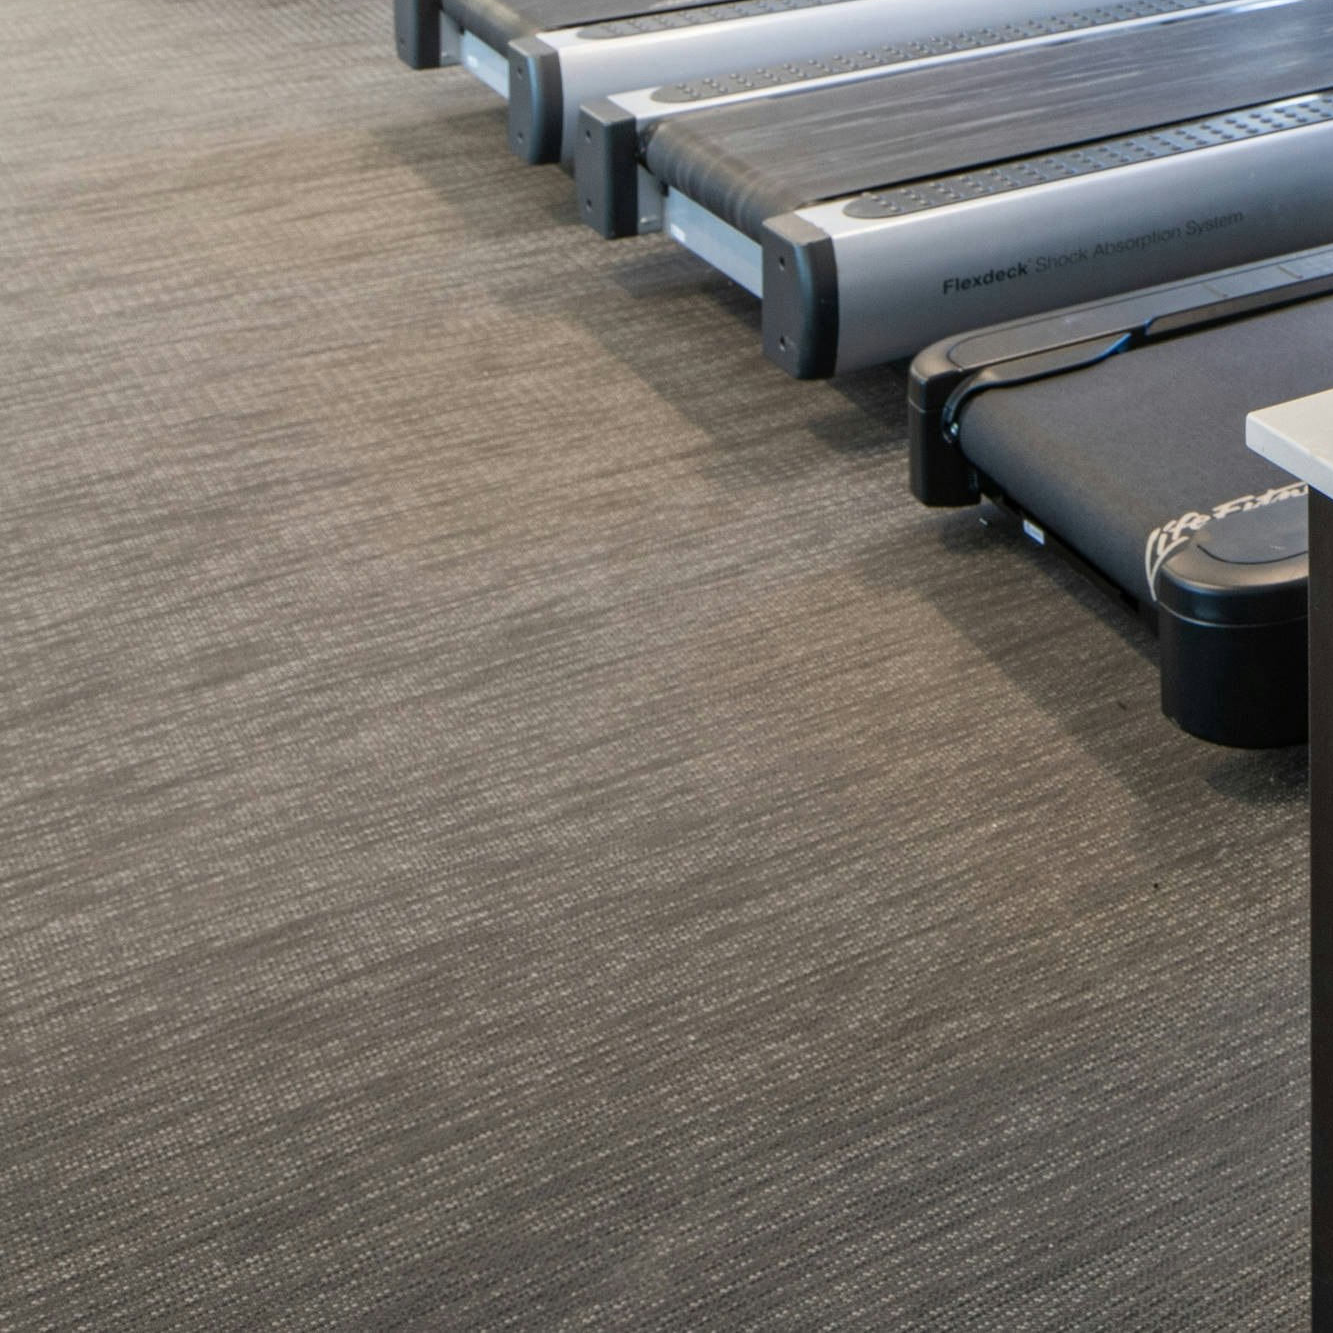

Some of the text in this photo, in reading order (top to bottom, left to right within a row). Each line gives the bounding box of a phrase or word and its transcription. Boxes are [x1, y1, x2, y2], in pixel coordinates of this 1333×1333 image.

[942, 212, 1243, 294] Flexdeck Shock Absorption System
[1145, 481, 1309, 602] Life Fitn
